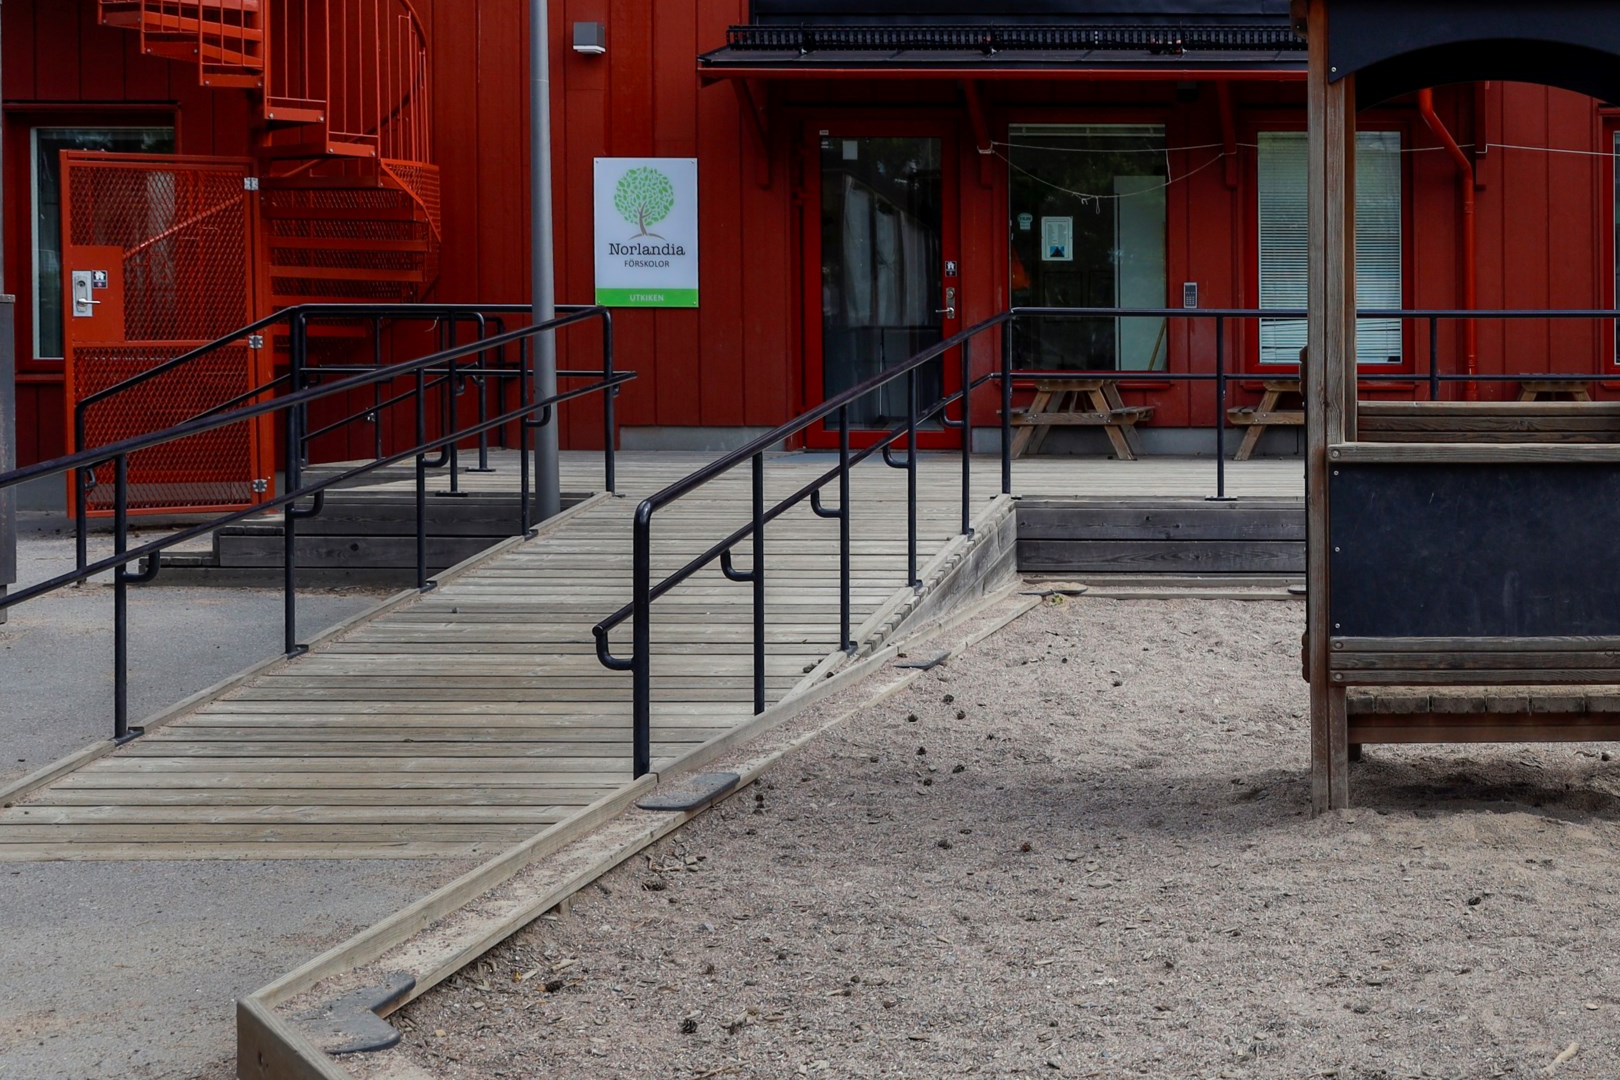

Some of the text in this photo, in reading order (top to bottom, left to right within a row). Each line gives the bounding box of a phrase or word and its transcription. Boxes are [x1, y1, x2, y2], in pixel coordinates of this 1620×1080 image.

[608, 243, 686, 255] Norlandia
[624, 259, 670, 268] FÖRSKOLOR
[629, 294, 664, 302] UTKIKEN
